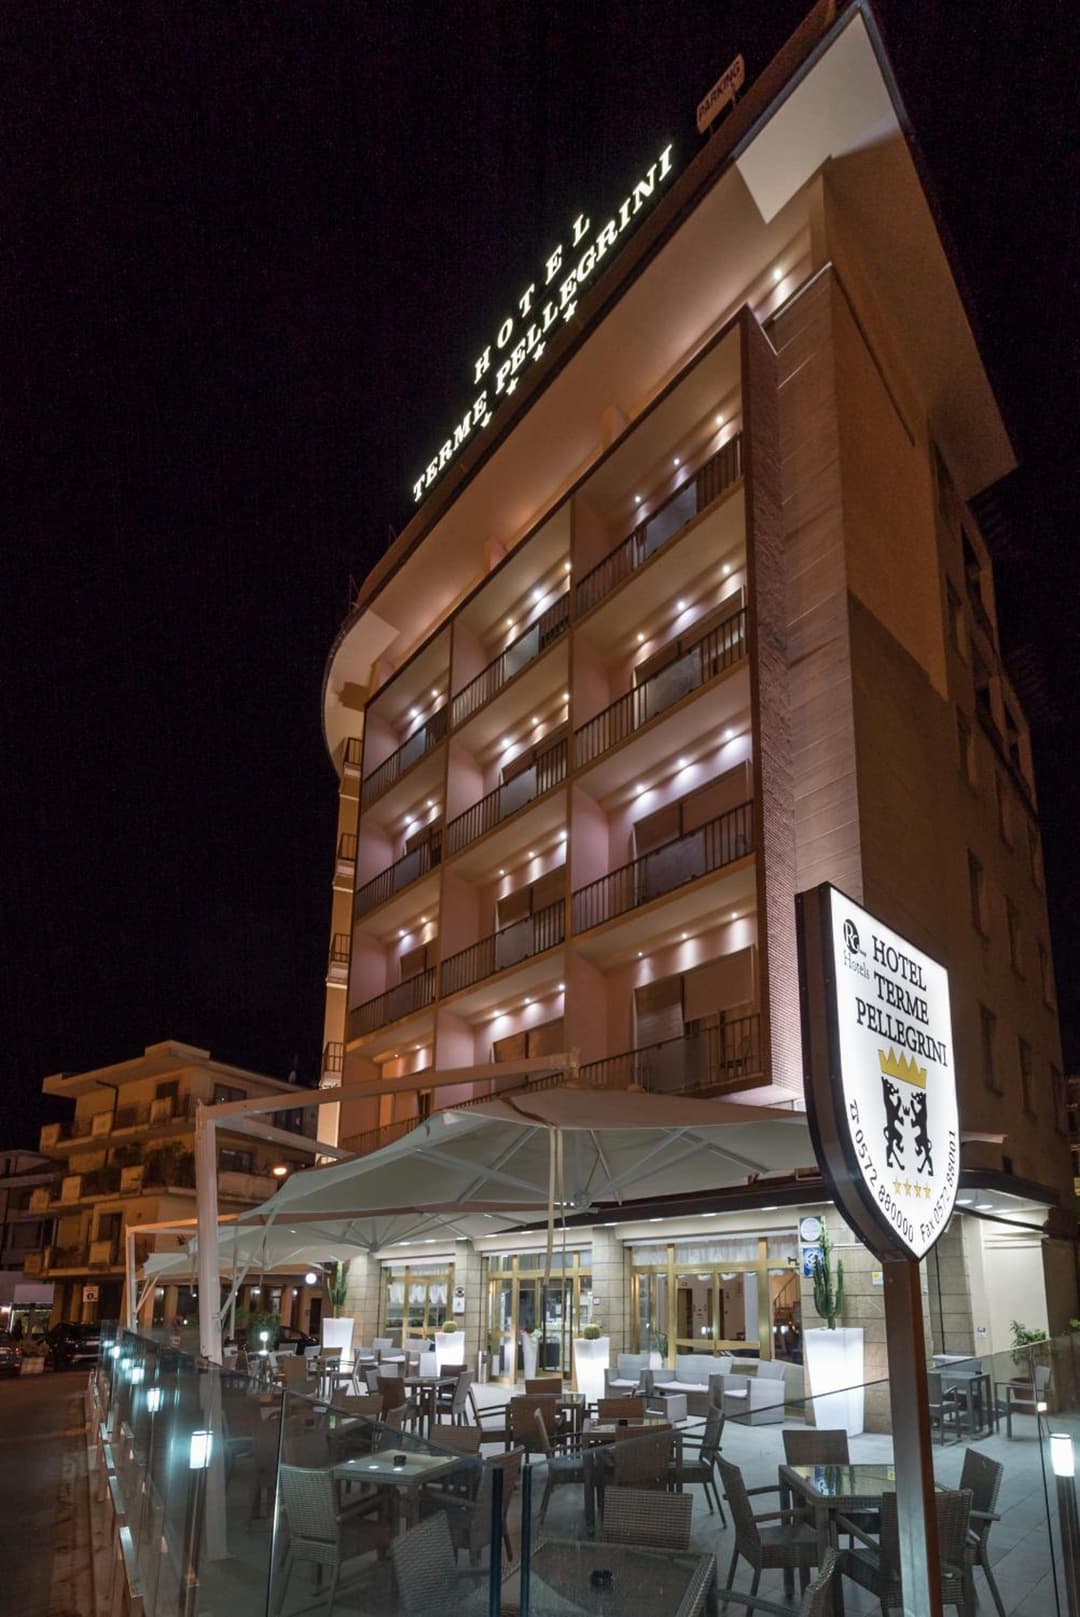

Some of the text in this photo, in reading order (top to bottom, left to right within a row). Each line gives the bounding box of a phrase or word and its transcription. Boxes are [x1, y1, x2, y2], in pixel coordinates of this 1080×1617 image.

[698, 59, 743, 120] PARKING
[413, 144, 673, 502] TERME PELLEGRINI
[474, 213, 591, 384] HOTEL
[844, 950, 870, 979] Hotels
[872, 935, 926, 992] HOTEL
[874, 970, 929, 1025] TERME
[856, 997, 947, 1067] PELLEGRINI
[855, 1129, 913, 1243] 0572 880000
[920, 1220, 936, 1243] Fax
